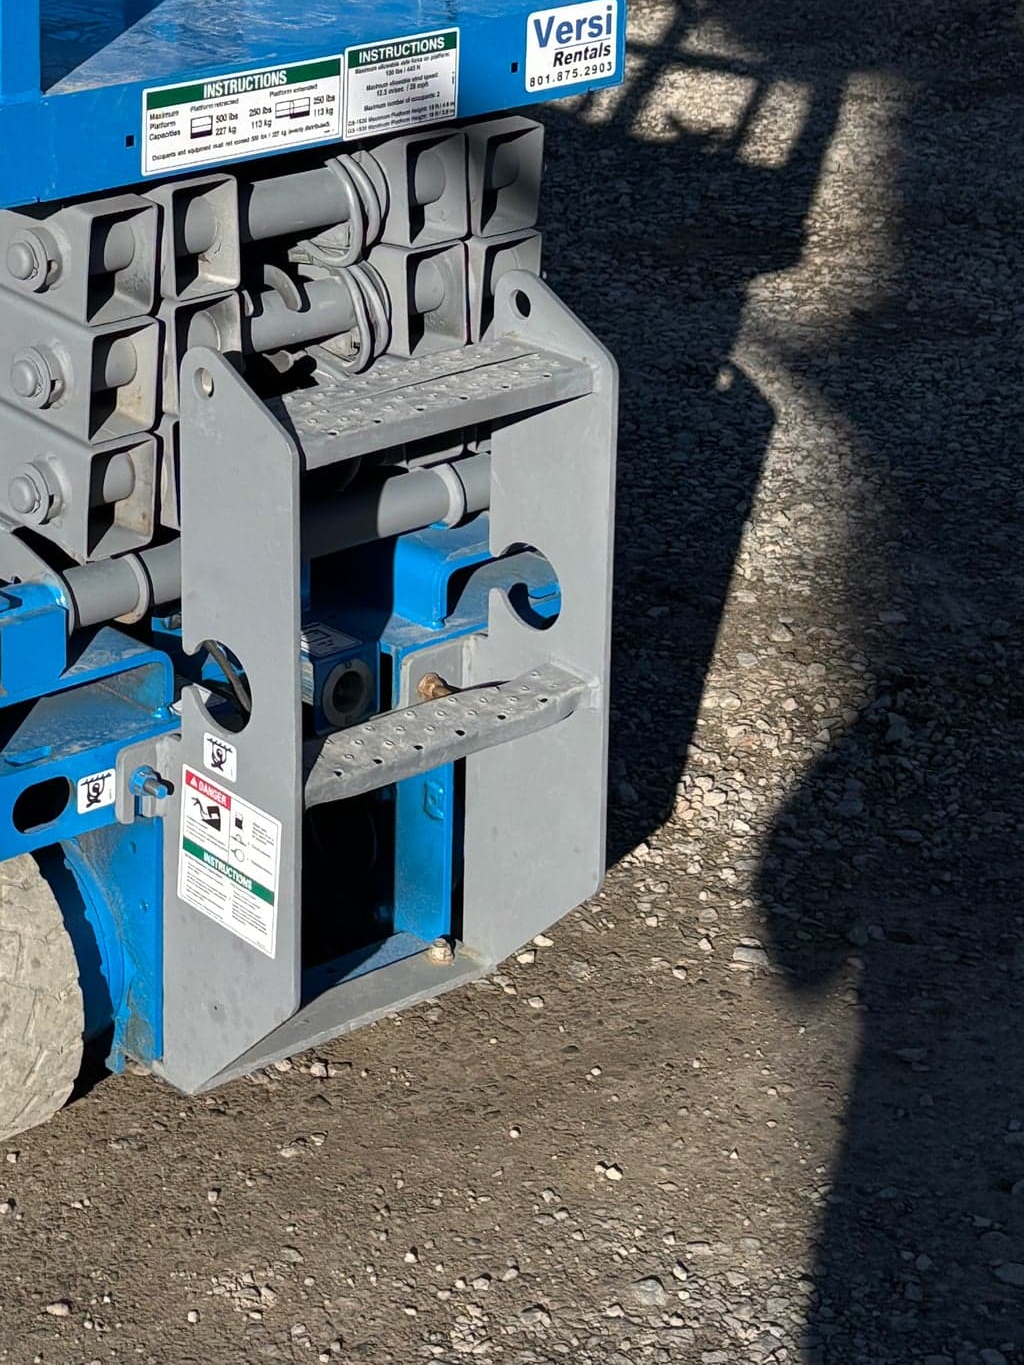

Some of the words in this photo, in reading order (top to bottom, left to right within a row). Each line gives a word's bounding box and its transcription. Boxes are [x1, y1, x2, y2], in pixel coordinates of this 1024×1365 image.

[533, 5, 612, 48] Versi
[358, 37, 444, 63] INSTRUCTIONS
[553, 42, 611, 67] Rentals
[203, 70, 287, 98] INSTRUCTIONS
[529, 61, 612, 87] 801.875.2903
[149, 109, 178, 120] Maximum
[215, 114, 226, 122] 500
[228, 112, 238, 120] lbs
[263, 118, 272, 127] kg
[325, 106, 333, 115] kg
[149, 120, 175, 130] Platform
[228, 125, 236, 134] kg
[199, 780, 227, 805] DANGER
[204, 850, 253, 890] INSTRUCTIONS
